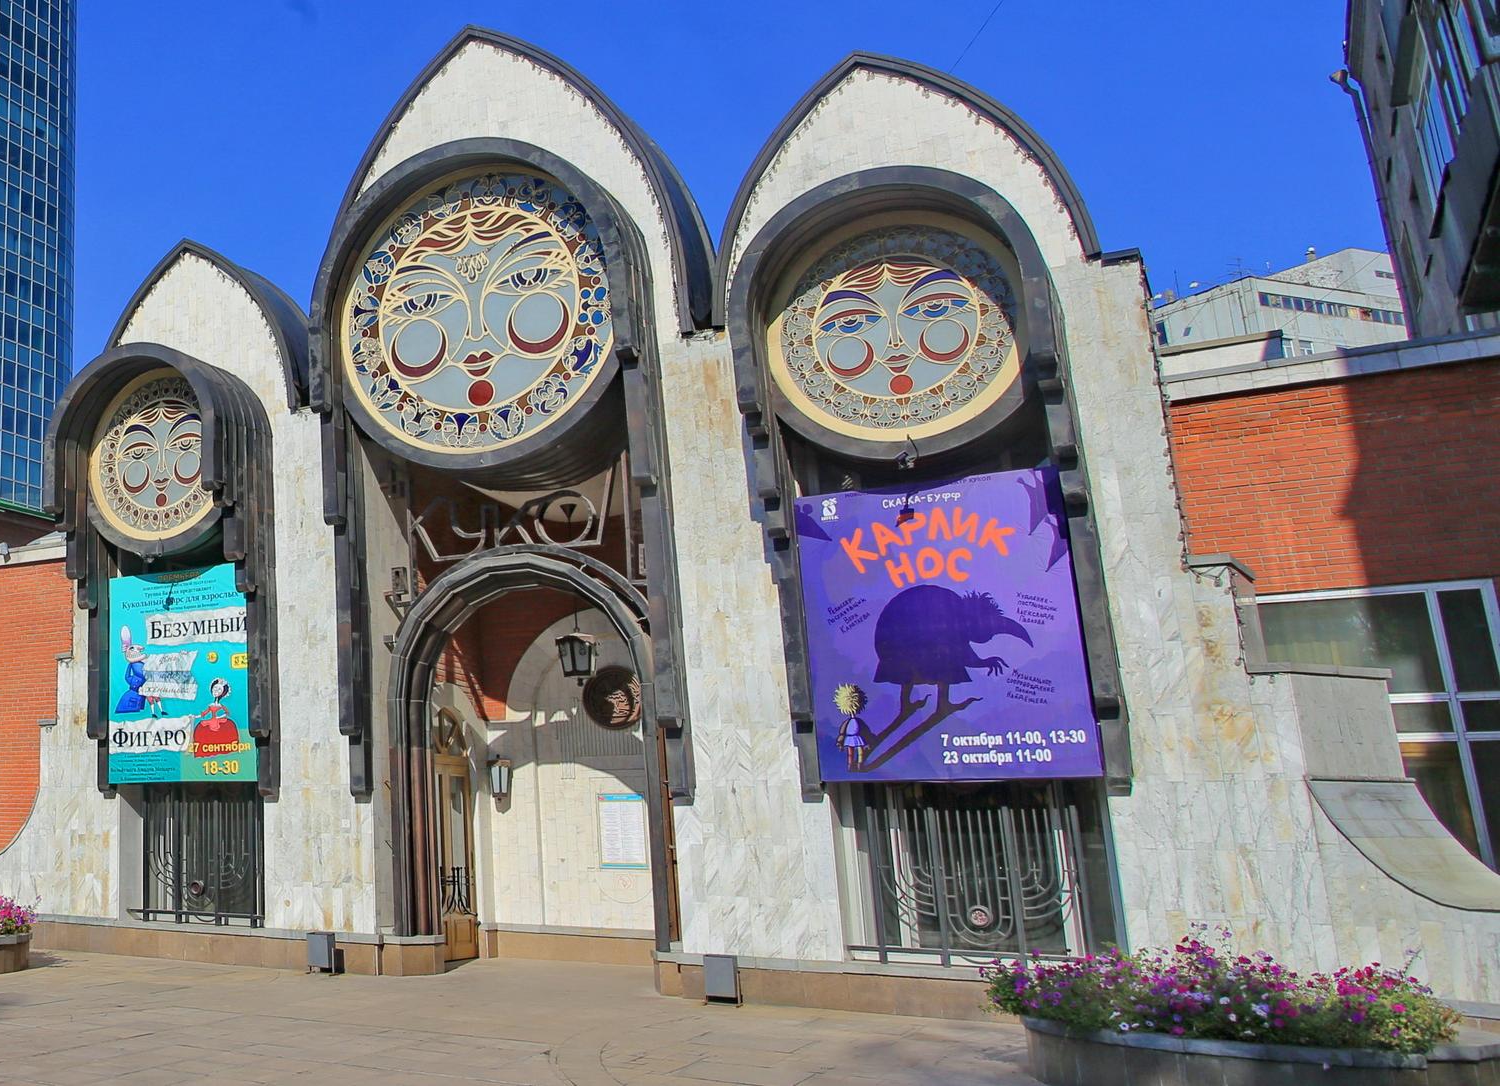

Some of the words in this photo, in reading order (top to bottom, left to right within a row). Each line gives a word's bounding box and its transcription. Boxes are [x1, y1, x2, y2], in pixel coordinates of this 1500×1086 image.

[840, 506, 1015, 573] КАРЛИК
[885, 547, 972, 588] НОС
[185, 595, 200, 603] для
[201, 591, 239, 602] взрослых
[112, 728, 186, 748] ФИГАРО
[941, 734, 949, 747] 7
[952, 733, 1003, 748] октября
[1006, 731, 1046, 746] 11-00,
[1050, 729, 1087, 744] 13-30
[188, 743, 199, 753] 27
[202, 741, 251, 754] сентября
[943, 751, 958, 764] 23
[962, 750, 1013, 766] октября
[1015, 749, 1052, 763] 11-00
[203, 760, 239, 775] 18-30
